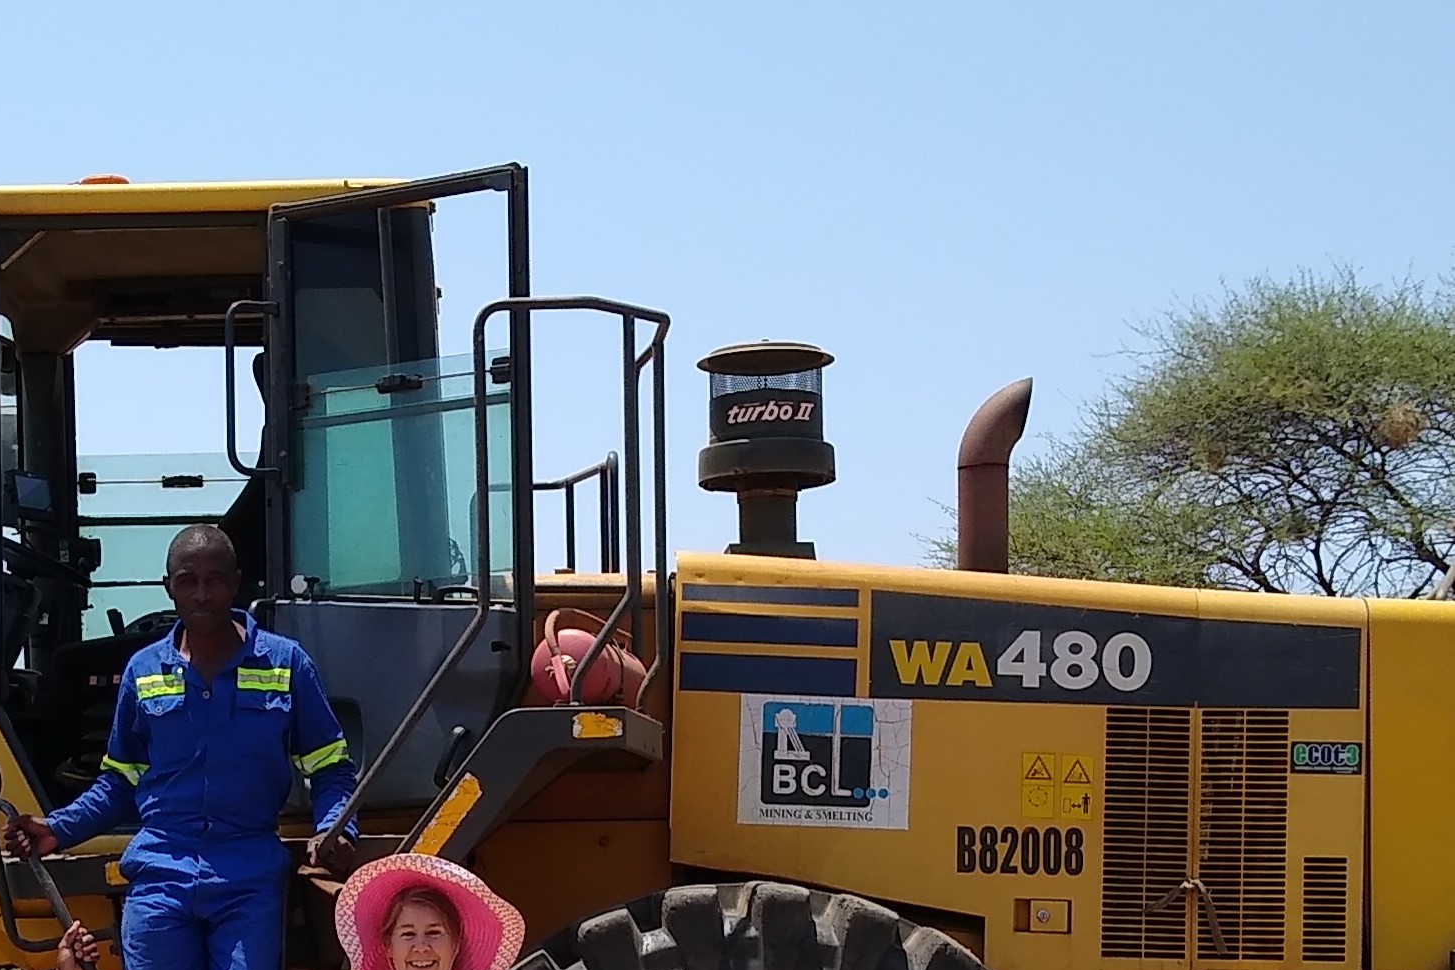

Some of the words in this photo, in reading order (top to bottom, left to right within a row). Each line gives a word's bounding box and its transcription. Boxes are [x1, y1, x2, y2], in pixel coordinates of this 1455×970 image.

[727, 401, 792, 424] turbo
[1294, 744, 1359, 766] ecot3
[759, 808, 802, 819] MINING
[805, 810, 813, 820] &
[815, 810, 873, 822] SMELTING
[956, 826, 1084, 876] B82008
